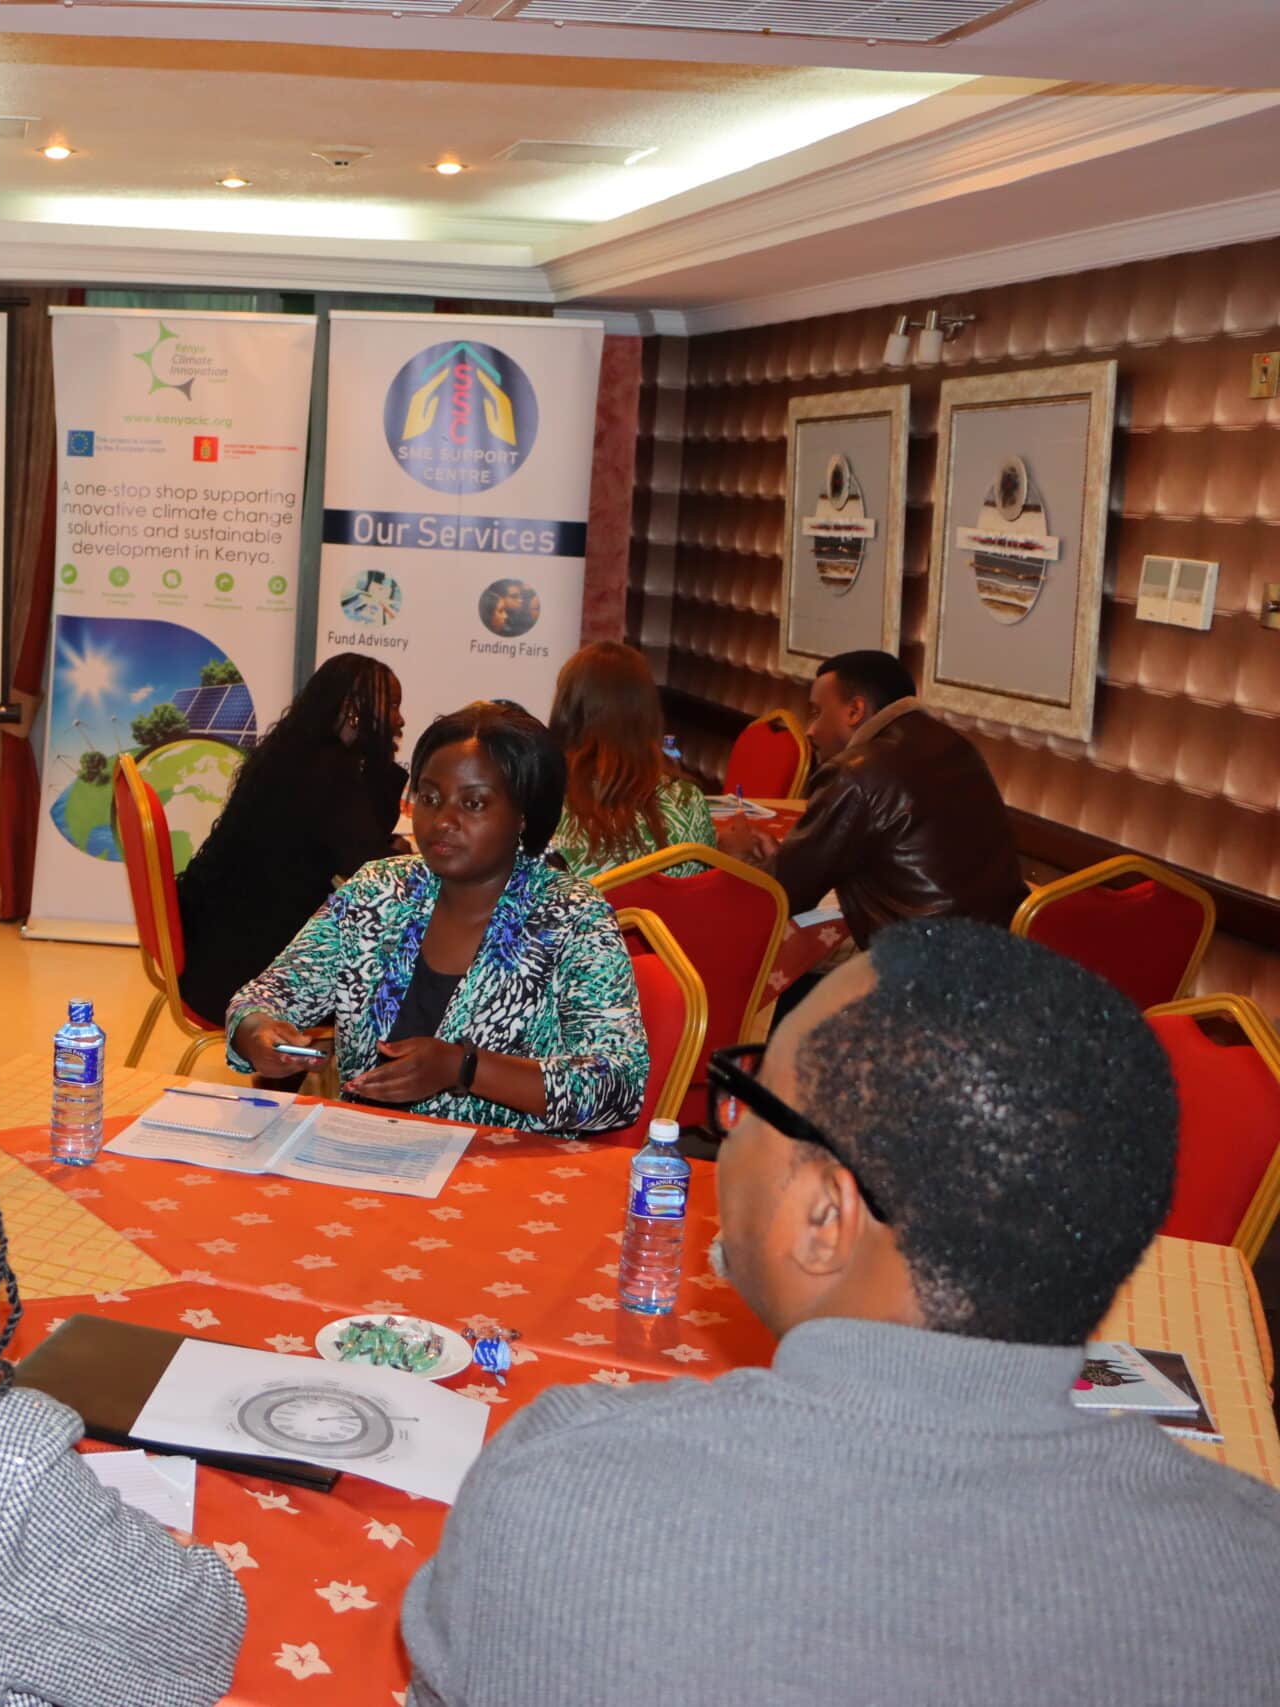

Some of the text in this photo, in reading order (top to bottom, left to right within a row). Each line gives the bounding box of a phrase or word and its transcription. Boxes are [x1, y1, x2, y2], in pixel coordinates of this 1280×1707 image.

[398, 446, 519, 464] SME SUPPORT
[423, 467, 490, 483] CENTRE
[63, 480, 296, 508] A one-stop shop supporting
[152, 503, 218, 520] climate
[223, 507, 293, 528] change
[67, 520, 282, 544] solutions and sustainable
[353, 513, 556, 553] Our Services
[72, 540, 190, 559] development
[195, 545, 209, 560] in
[327, 631, 409, 651] Fund Advisory
[470, 639, 549, 658] Funding Fairs
